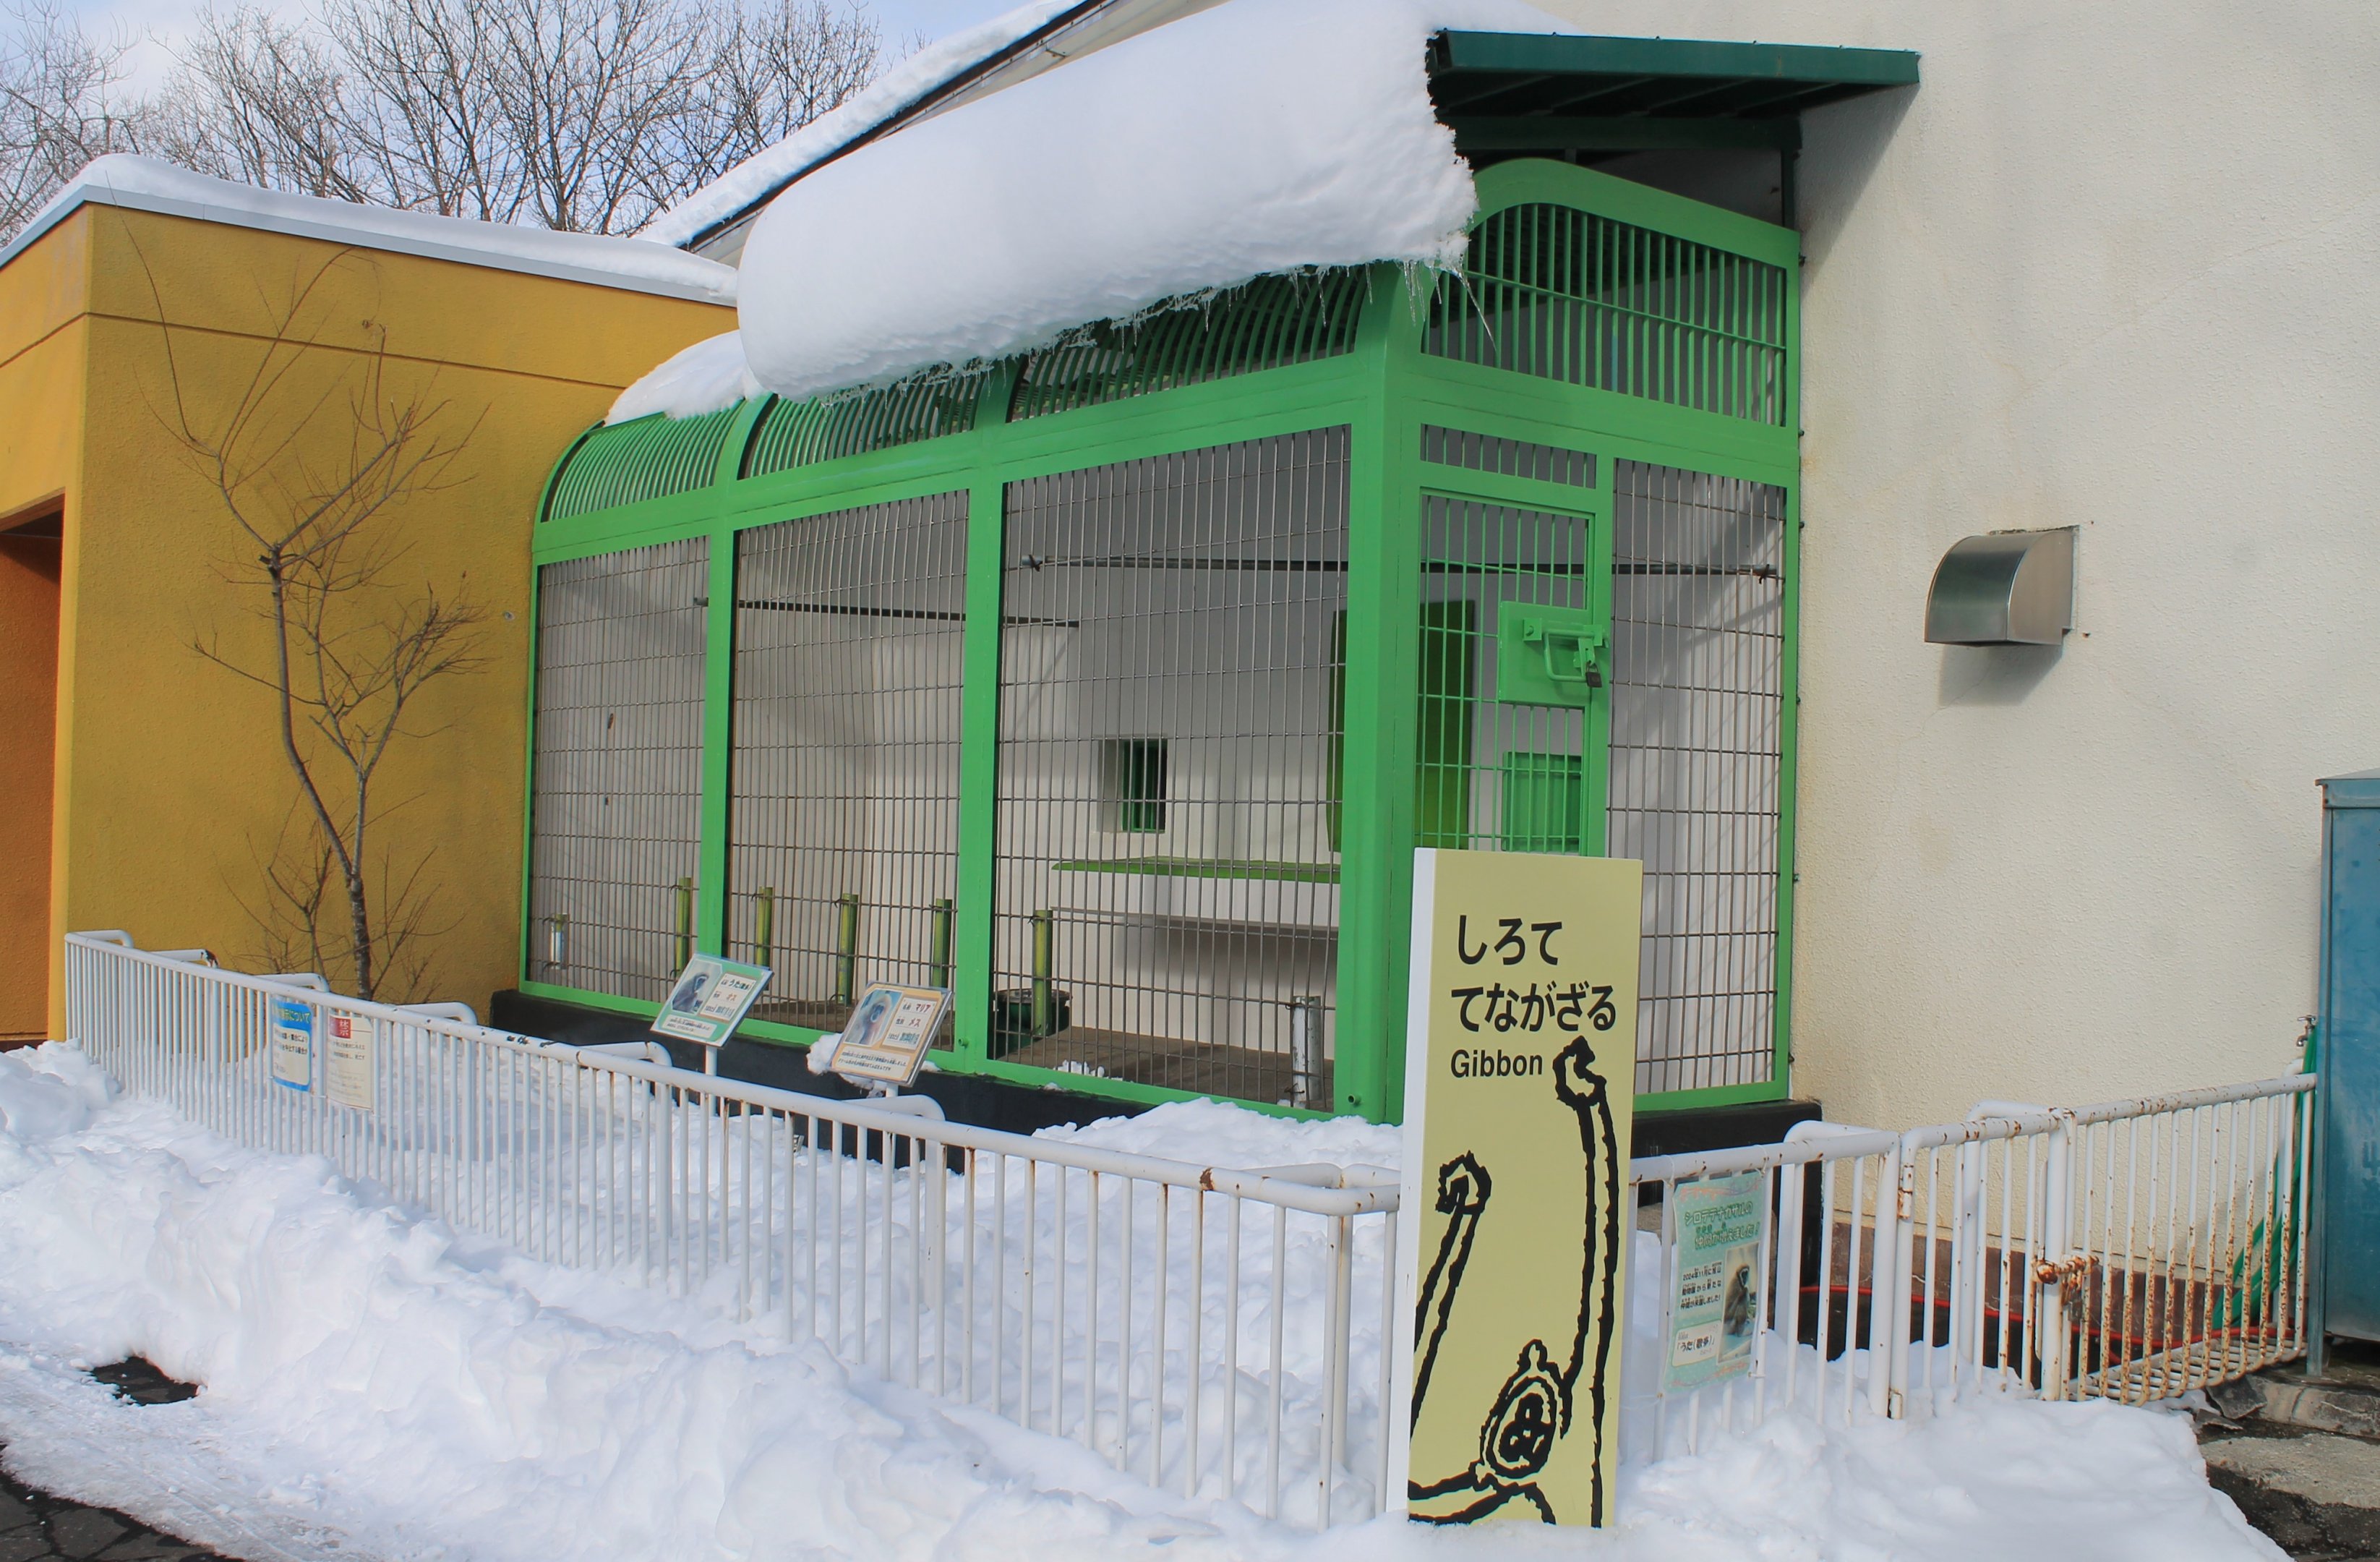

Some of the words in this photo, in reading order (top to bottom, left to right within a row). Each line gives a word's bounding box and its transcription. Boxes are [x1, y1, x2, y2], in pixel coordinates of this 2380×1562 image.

[1457, 914, 1562, 965] しろて
[915, 1003, 931, 1013] マリア
[1451, 980, 1617, 1032] てながざる
[1450, 1049, 1543, 1078] Gibbon
